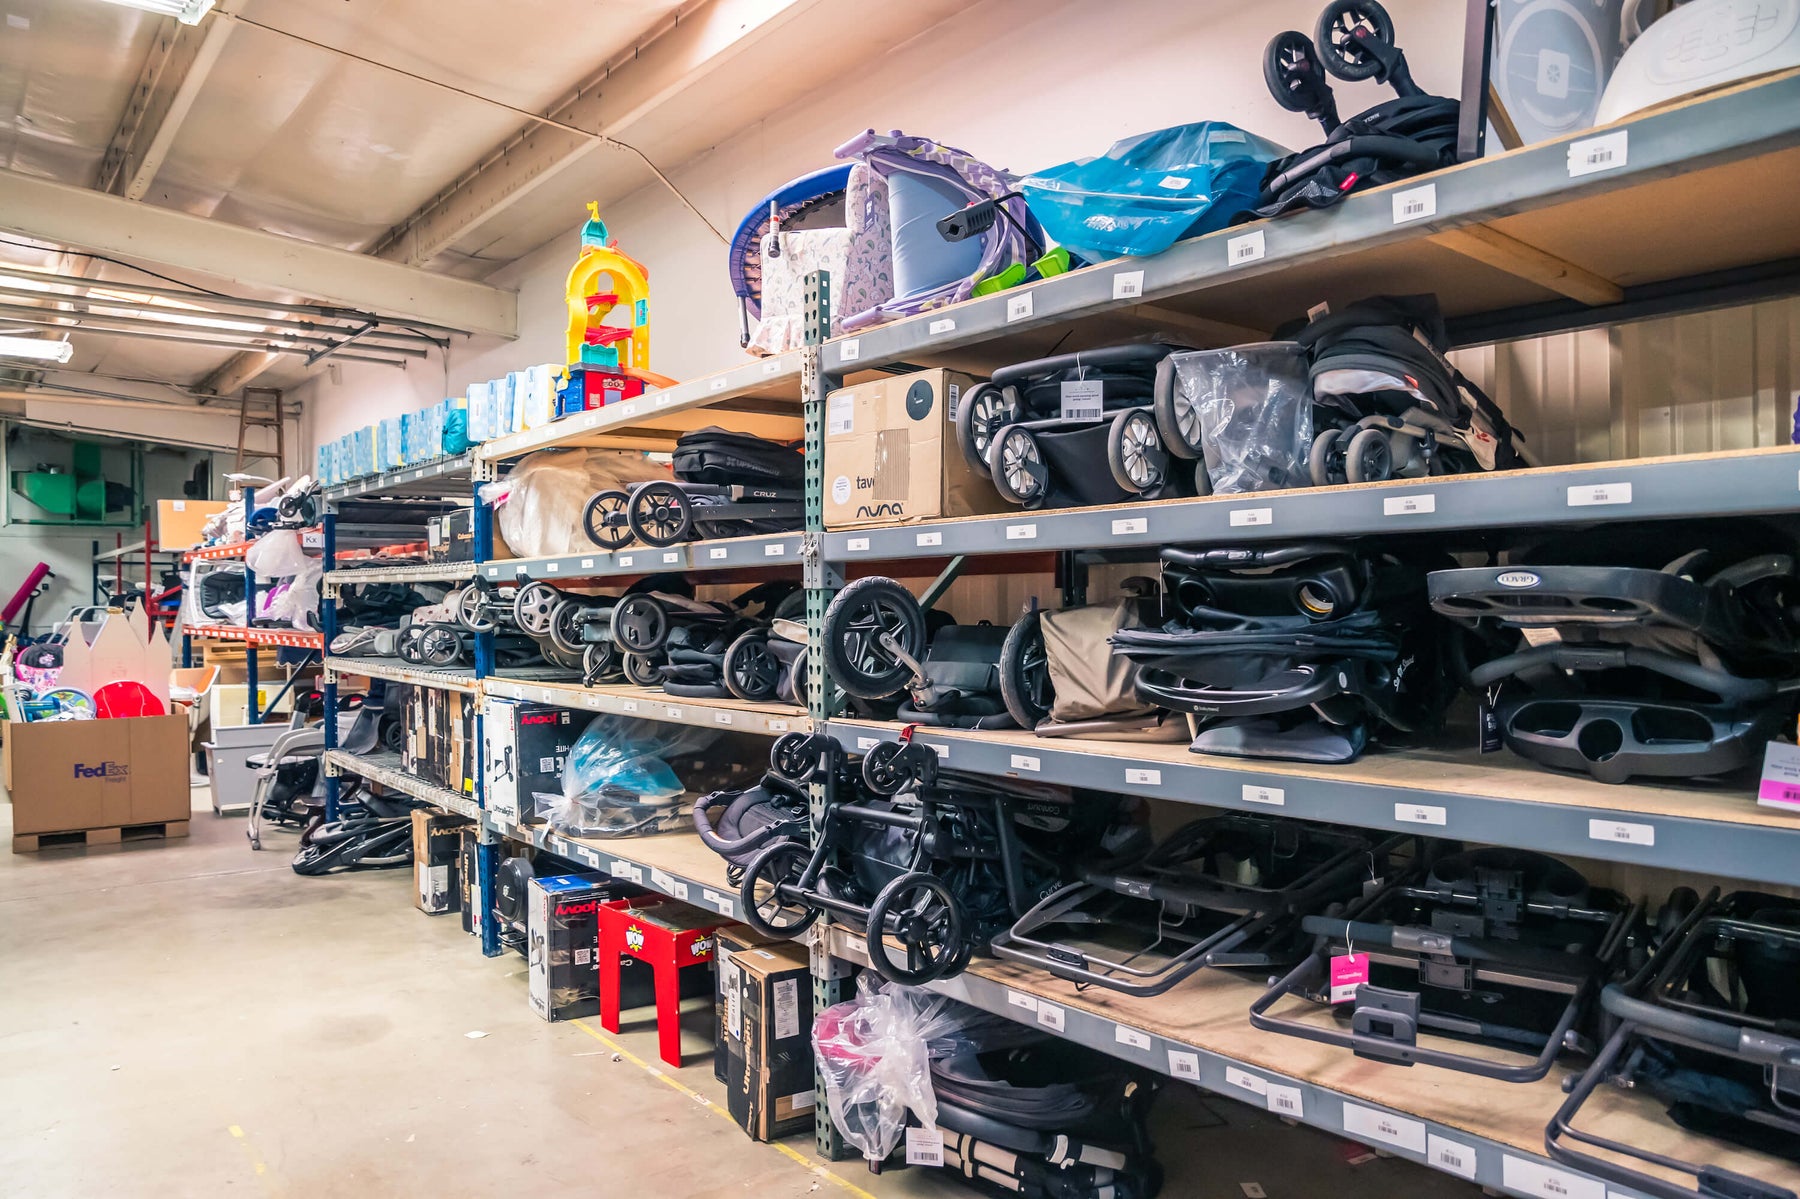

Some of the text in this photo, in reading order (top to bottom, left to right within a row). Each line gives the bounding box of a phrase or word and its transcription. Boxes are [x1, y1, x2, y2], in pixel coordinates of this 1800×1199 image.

[753, 490, 777, 498] CRUZ
[1501, 575, 1535, 583] GRACO
[520, 712, 558, 726] joovy
[74, 761, 129, 779] FedEx
[1039, 880, 1063, 900] Curve
[555, 900, 598, 916] joovy
[625, 930, 645, 948] WOW
[742, 1016, 754, 1095] Ultralight
